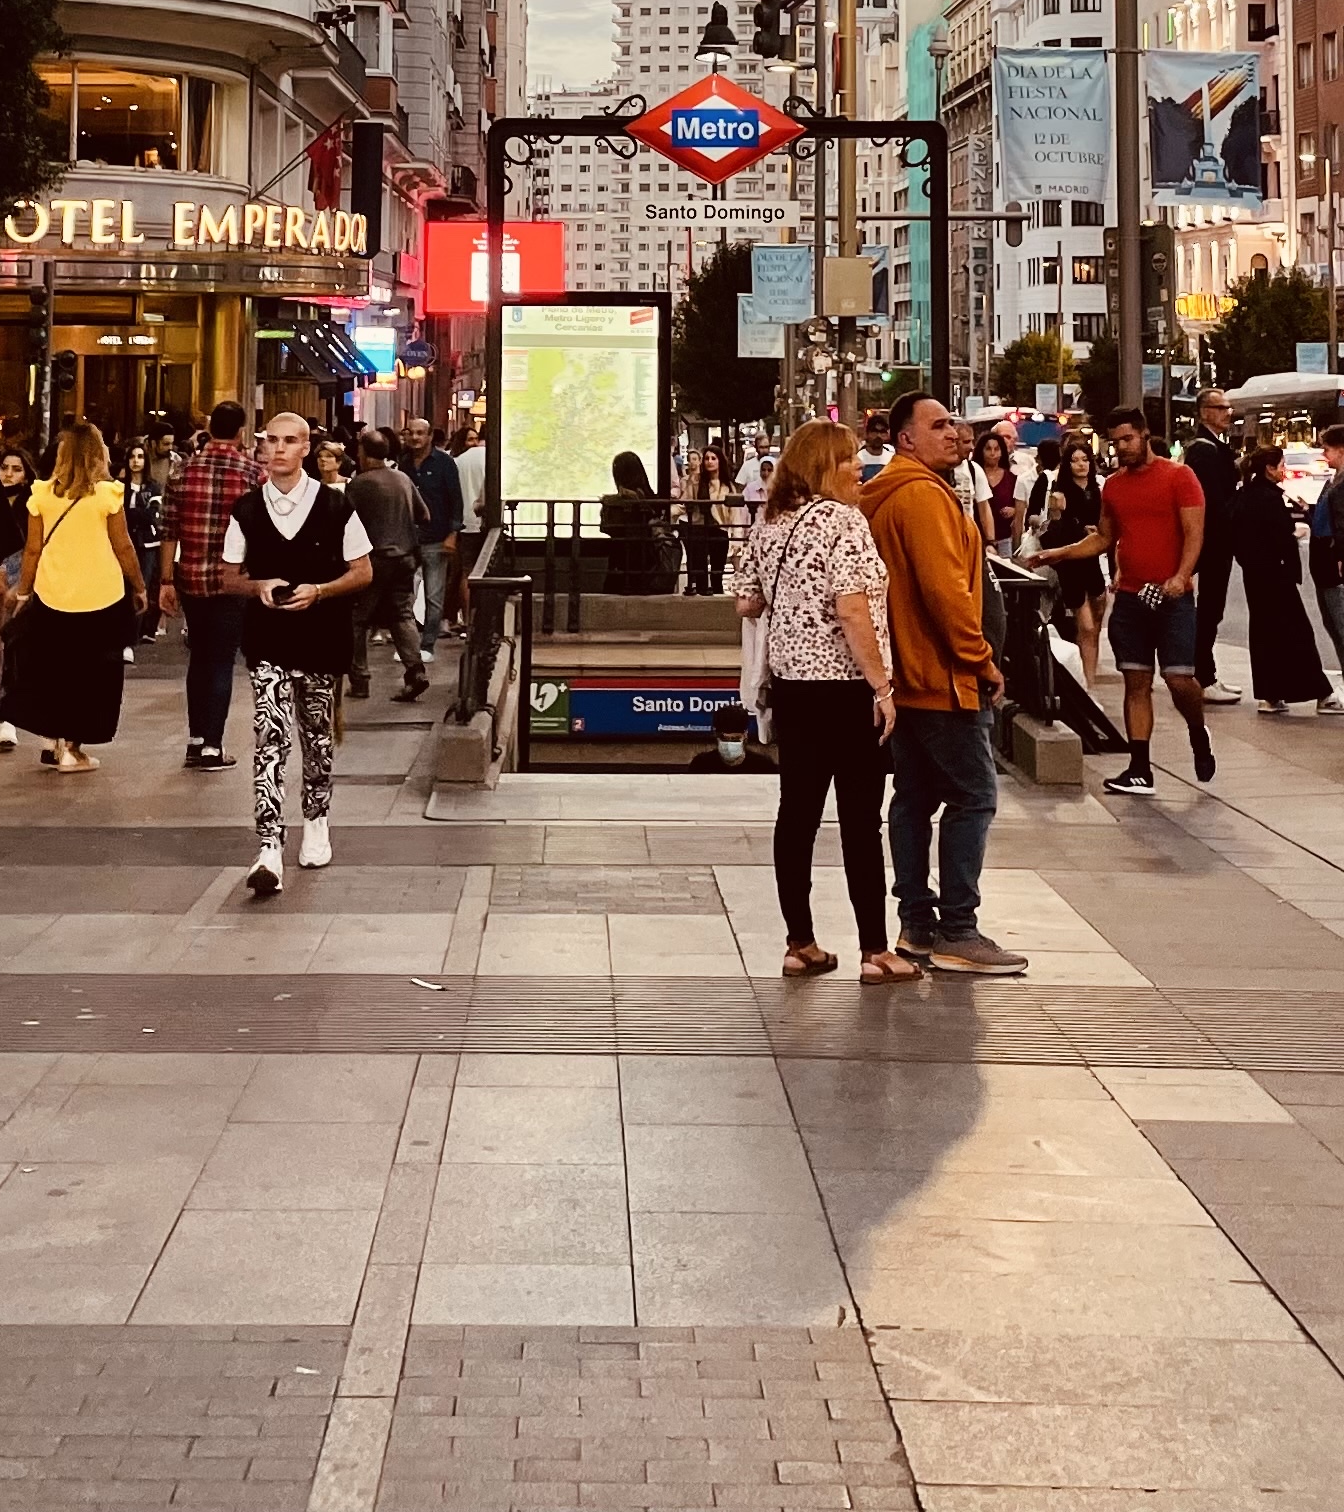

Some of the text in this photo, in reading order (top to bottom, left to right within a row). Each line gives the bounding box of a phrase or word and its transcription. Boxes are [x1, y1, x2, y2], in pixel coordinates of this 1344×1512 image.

[1043, 66, 1067, 79] DE
[1070, 67, 1093, 80] LA
[1008, 86, 1068, 99] FIESTA
[1010, 106, 1104, 121] NACIONAL
[677, 117, 755, 140] Metro
[1035, 133, 1071, 145] 12 DE
[1035, 151, 1105, 165] OCTUBRE
[1048, 185, 1089, 195] MADRID
[645, 204, 785, 223] Santo Domingo
[174, 201, 367, 255] EMPERADOR
[575, 315, 605, 324] Ligero
[632, 696, 684, 713] Santo
[573, 718, 583, 731] 2
